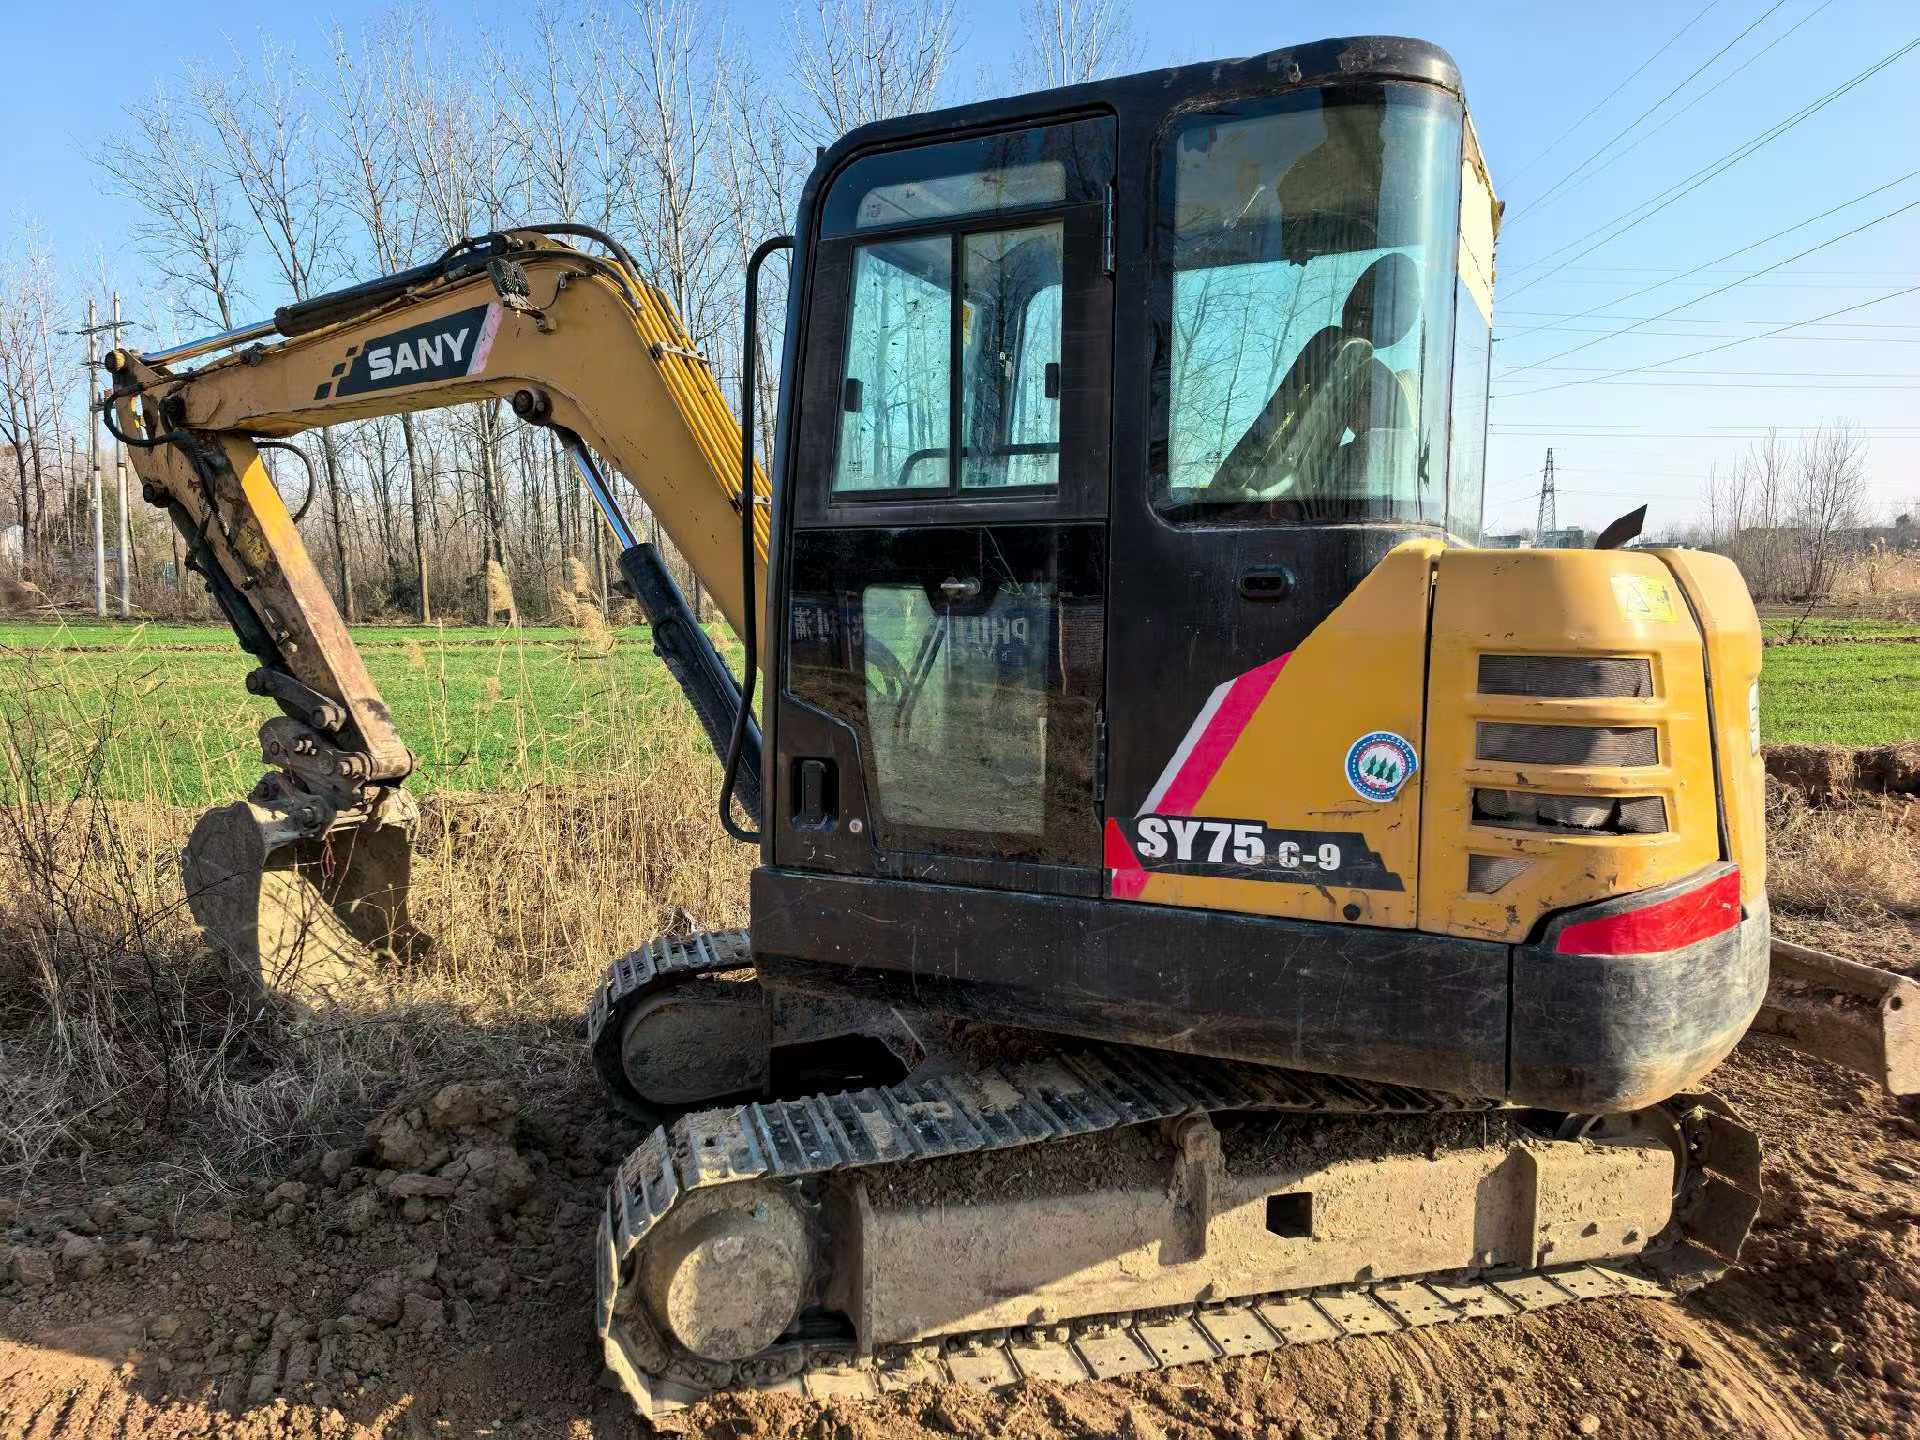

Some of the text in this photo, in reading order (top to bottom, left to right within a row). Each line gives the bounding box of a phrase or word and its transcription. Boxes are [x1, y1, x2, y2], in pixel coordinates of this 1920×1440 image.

[368, 328, 470, 380] SANY
[1136, 817, 1341, 871] SY75 C-9
